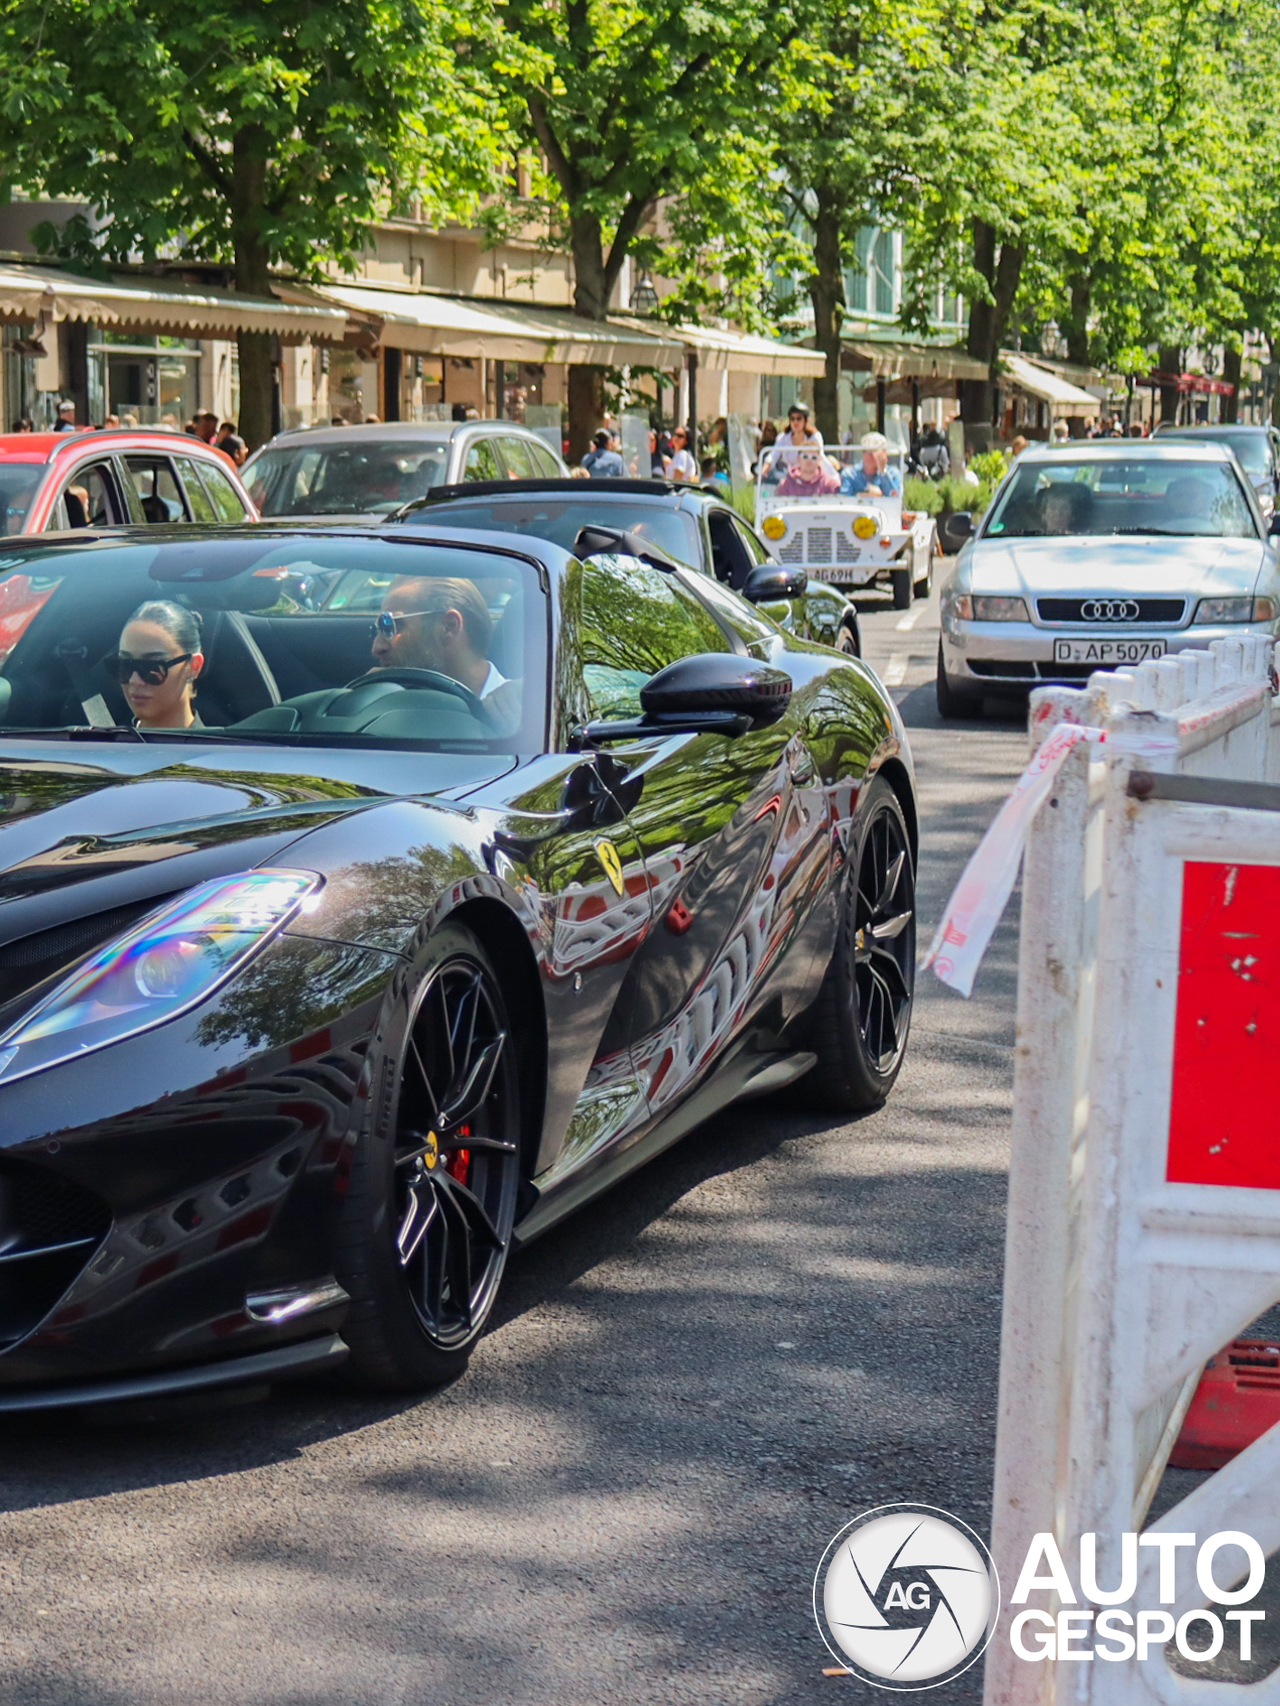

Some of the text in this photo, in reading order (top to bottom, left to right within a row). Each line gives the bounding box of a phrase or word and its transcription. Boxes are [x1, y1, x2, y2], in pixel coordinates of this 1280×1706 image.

[1058, 643, 1162, 661] D AP 5070
